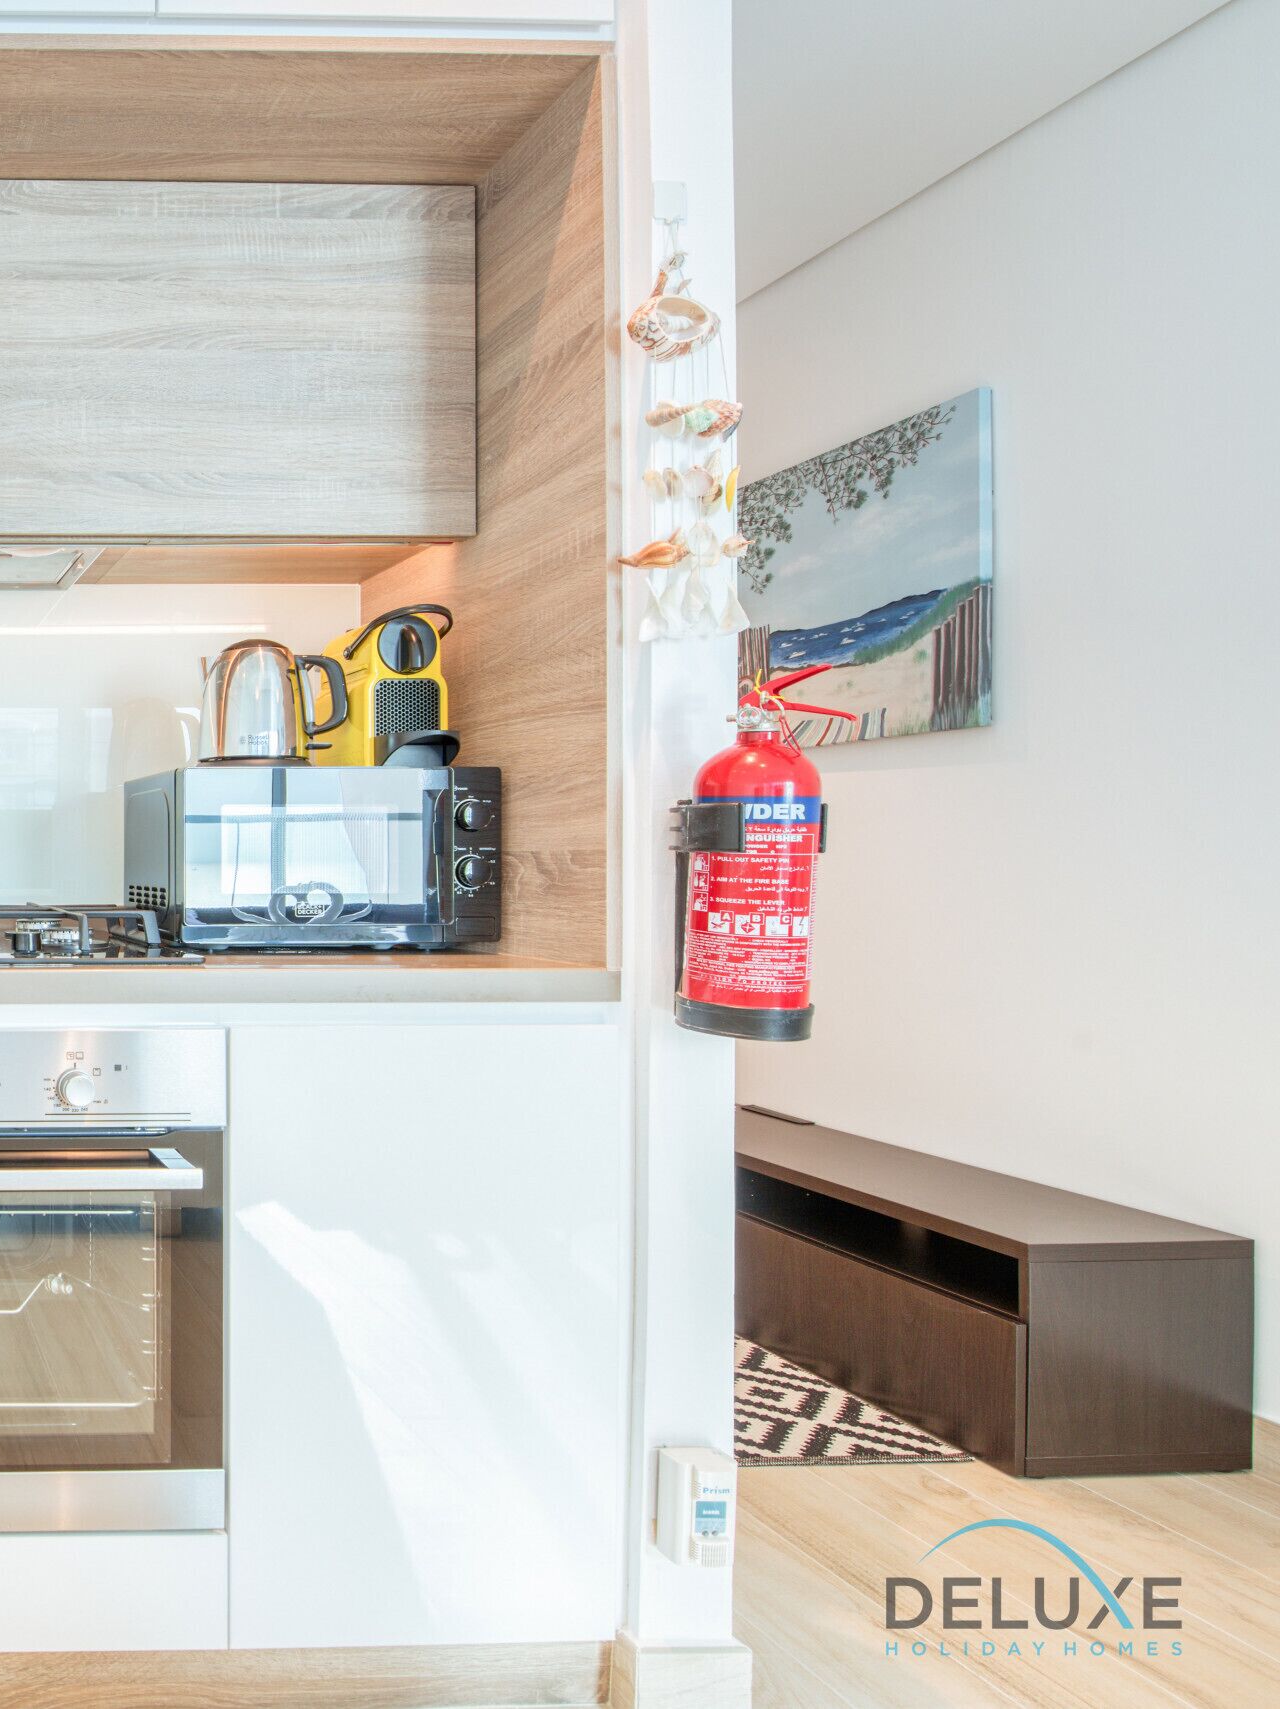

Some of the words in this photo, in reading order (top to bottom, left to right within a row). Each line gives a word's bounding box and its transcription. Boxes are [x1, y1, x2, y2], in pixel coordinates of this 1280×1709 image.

[722, 912, 731, 921] A
[752, 914, 761, 922] B
[782, 916, 791, 924] C
